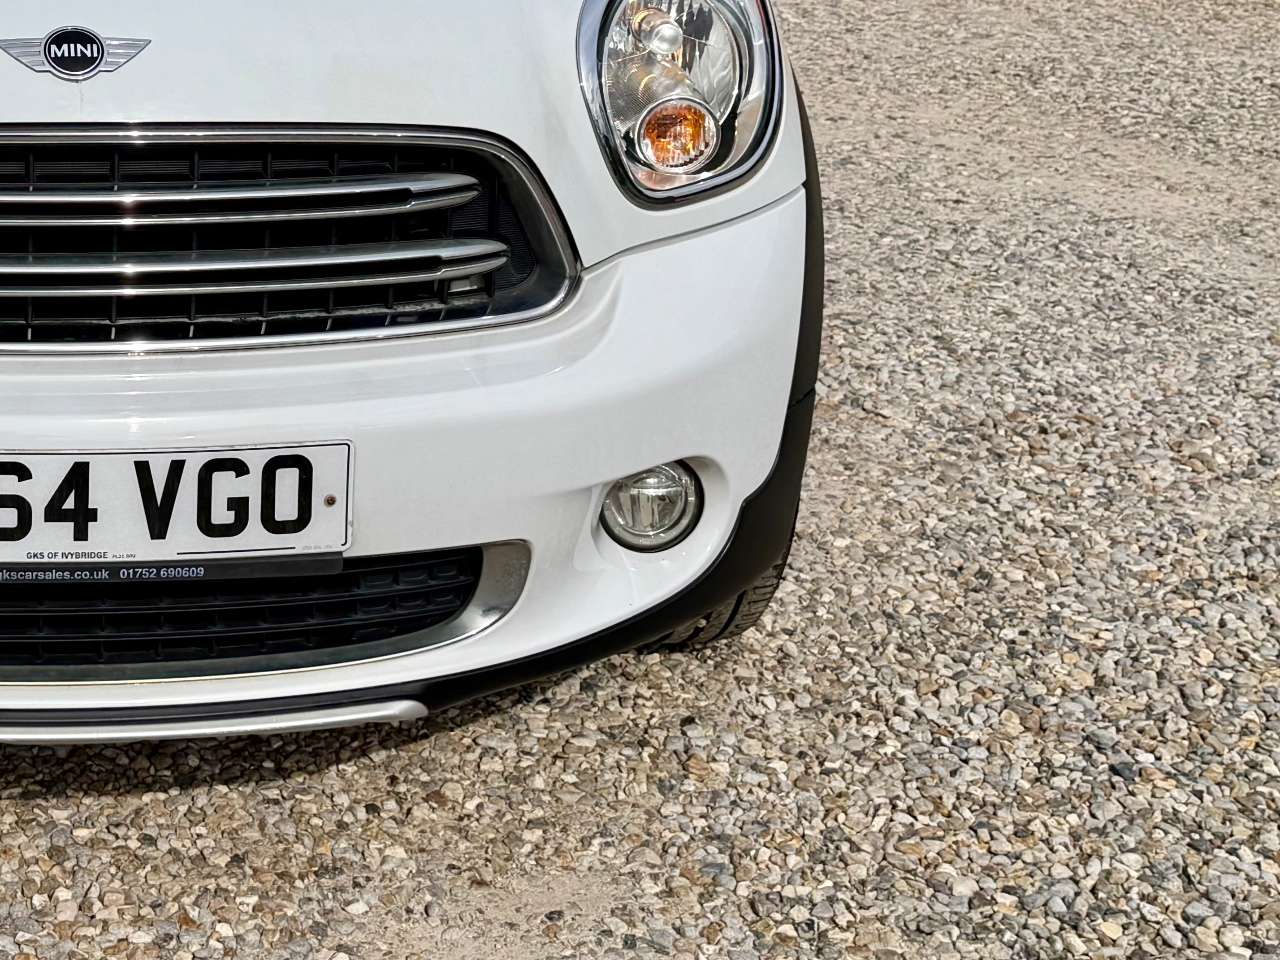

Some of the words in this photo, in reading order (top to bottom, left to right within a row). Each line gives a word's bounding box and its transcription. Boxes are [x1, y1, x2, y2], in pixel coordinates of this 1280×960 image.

[50, 43, 98, 58] MINI
[133, 453, 313, 541] VGO
[26, 551, 45, 560] GKS
[47, 551, 59, 559] OF
[61, 551, 109, 559] IVYBRIDGE
[119, 567, 157, 579] 01752
[160, 567, 205, 578] 690609
